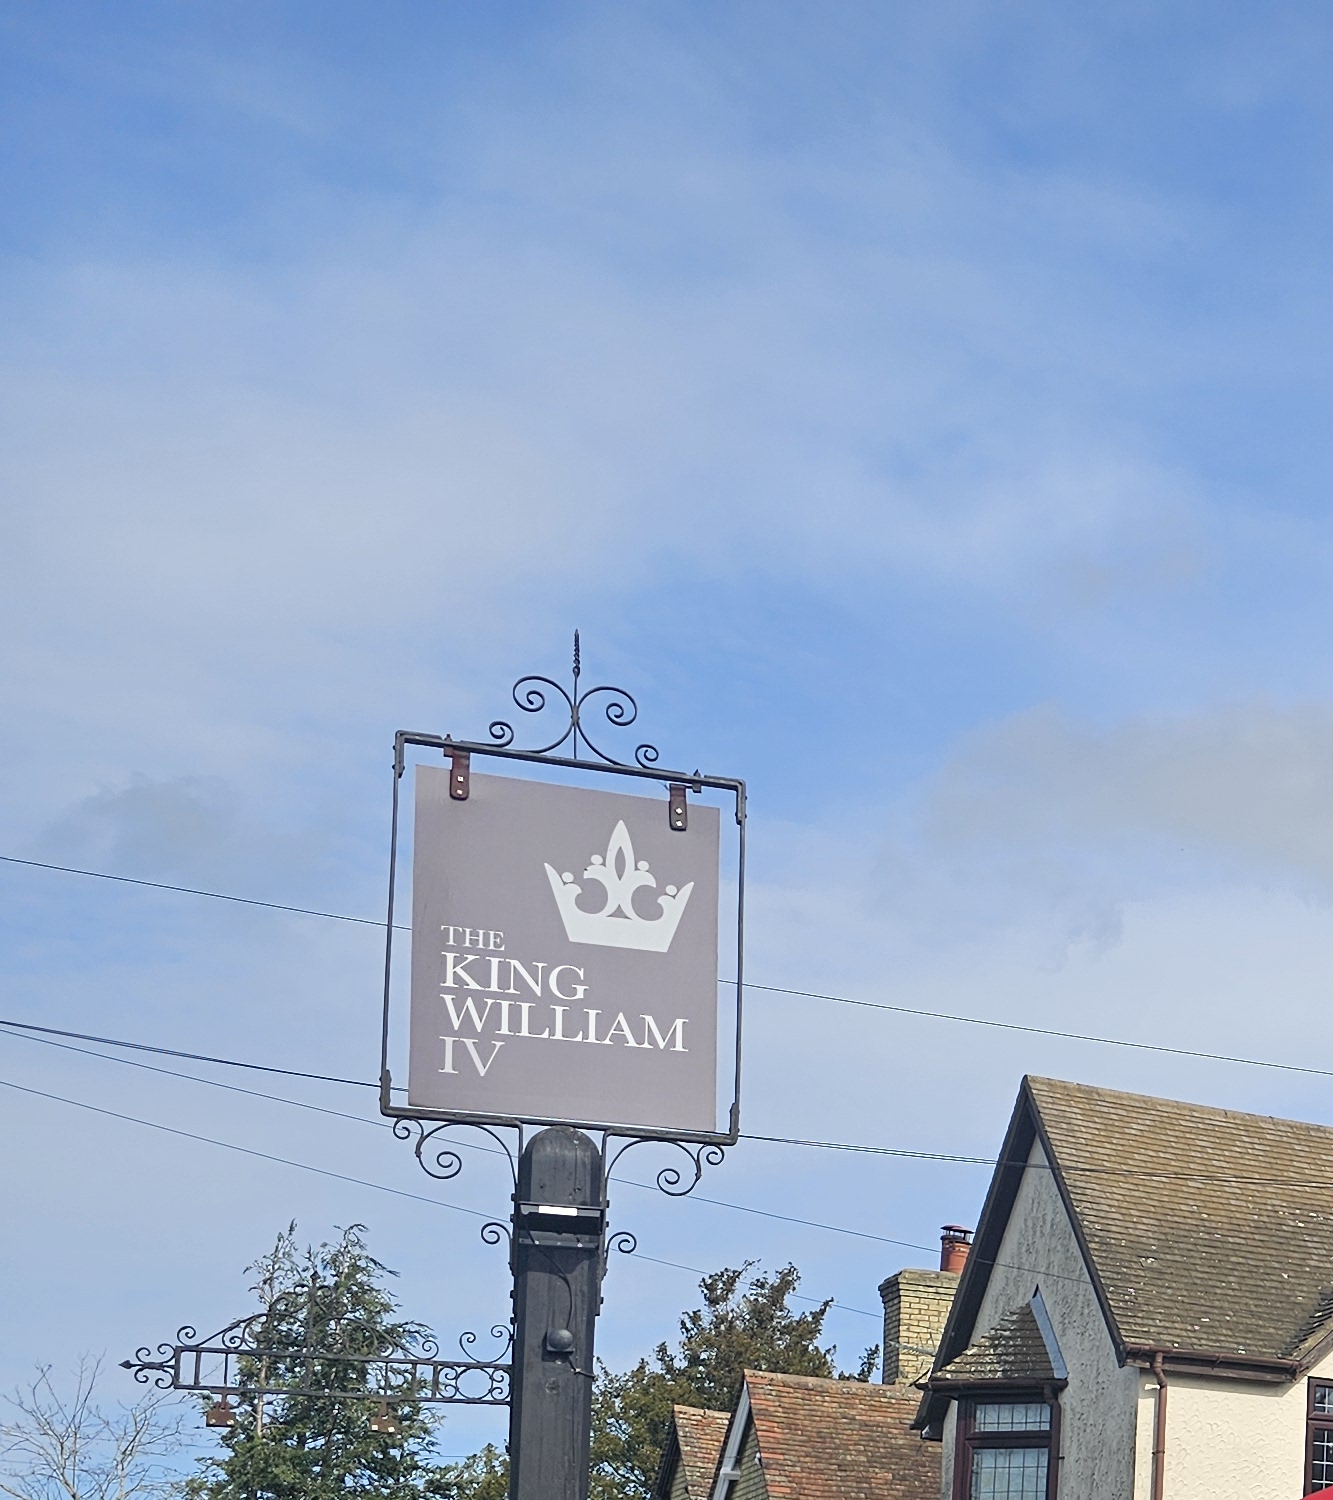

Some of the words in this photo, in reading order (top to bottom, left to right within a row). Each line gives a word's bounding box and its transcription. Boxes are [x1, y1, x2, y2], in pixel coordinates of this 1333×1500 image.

[441, 925, 505, 951] THE
[440, 952, 589, 1000] KING
[440, 994, 689, 1052] WILLIAM
[438, 1036, 506, 1077] IV
